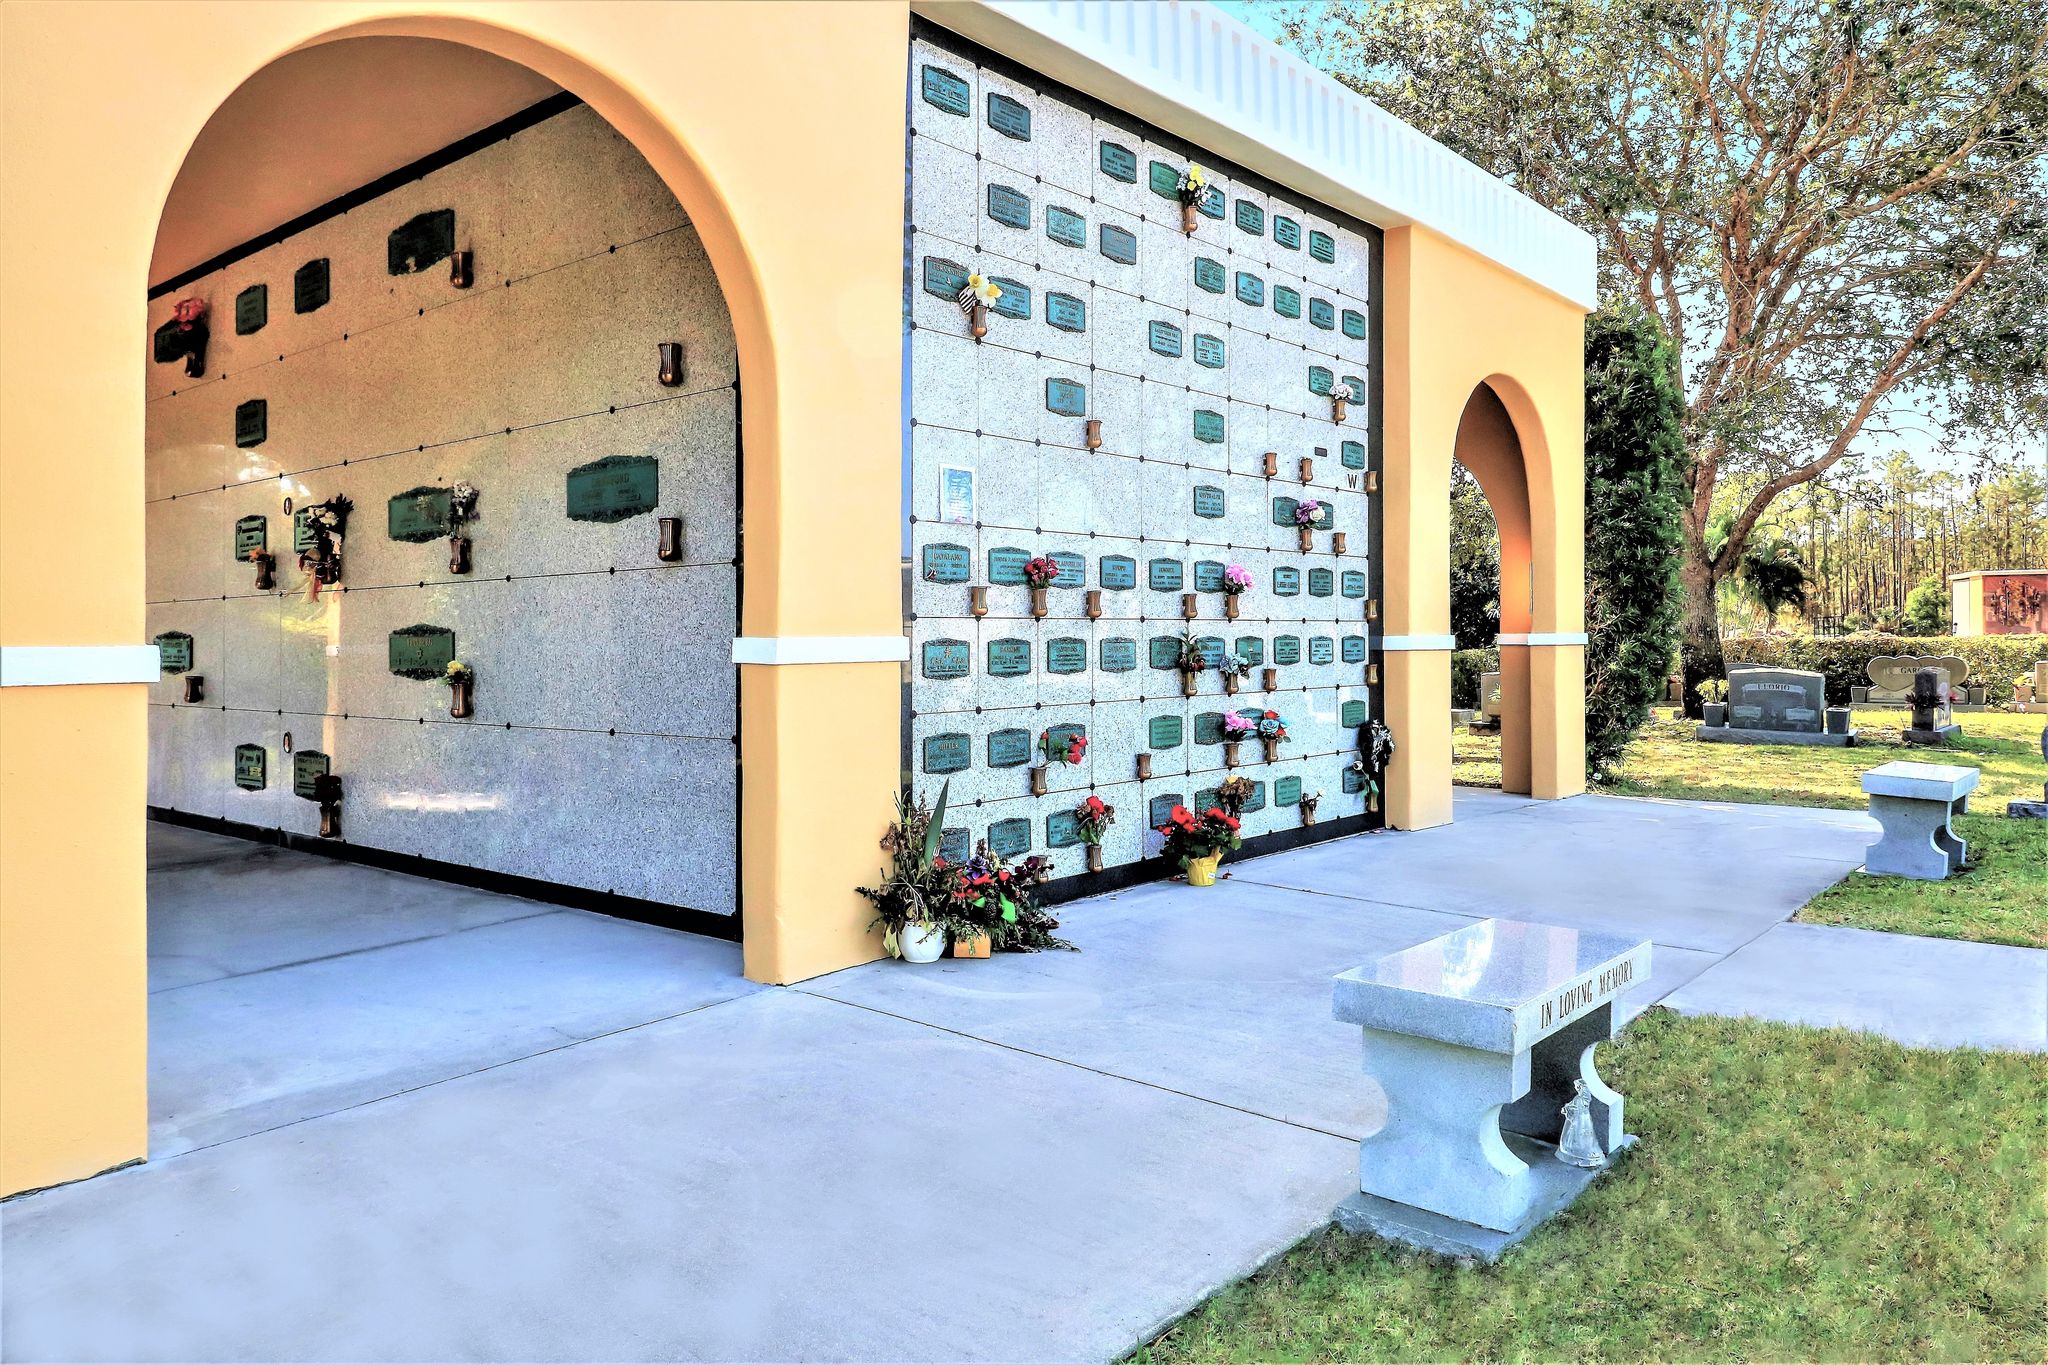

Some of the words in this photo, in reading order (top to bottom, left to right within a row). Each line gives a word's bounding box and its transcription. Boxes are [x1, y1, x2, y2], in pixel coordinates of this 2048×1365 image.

[1347, 474, 1357, 489] W
[1541, 1000, 1552, 1029] IN
[1559, 979, 1593, 1019] LOVING
[1599, 958, 1634, 997] MEMORY
